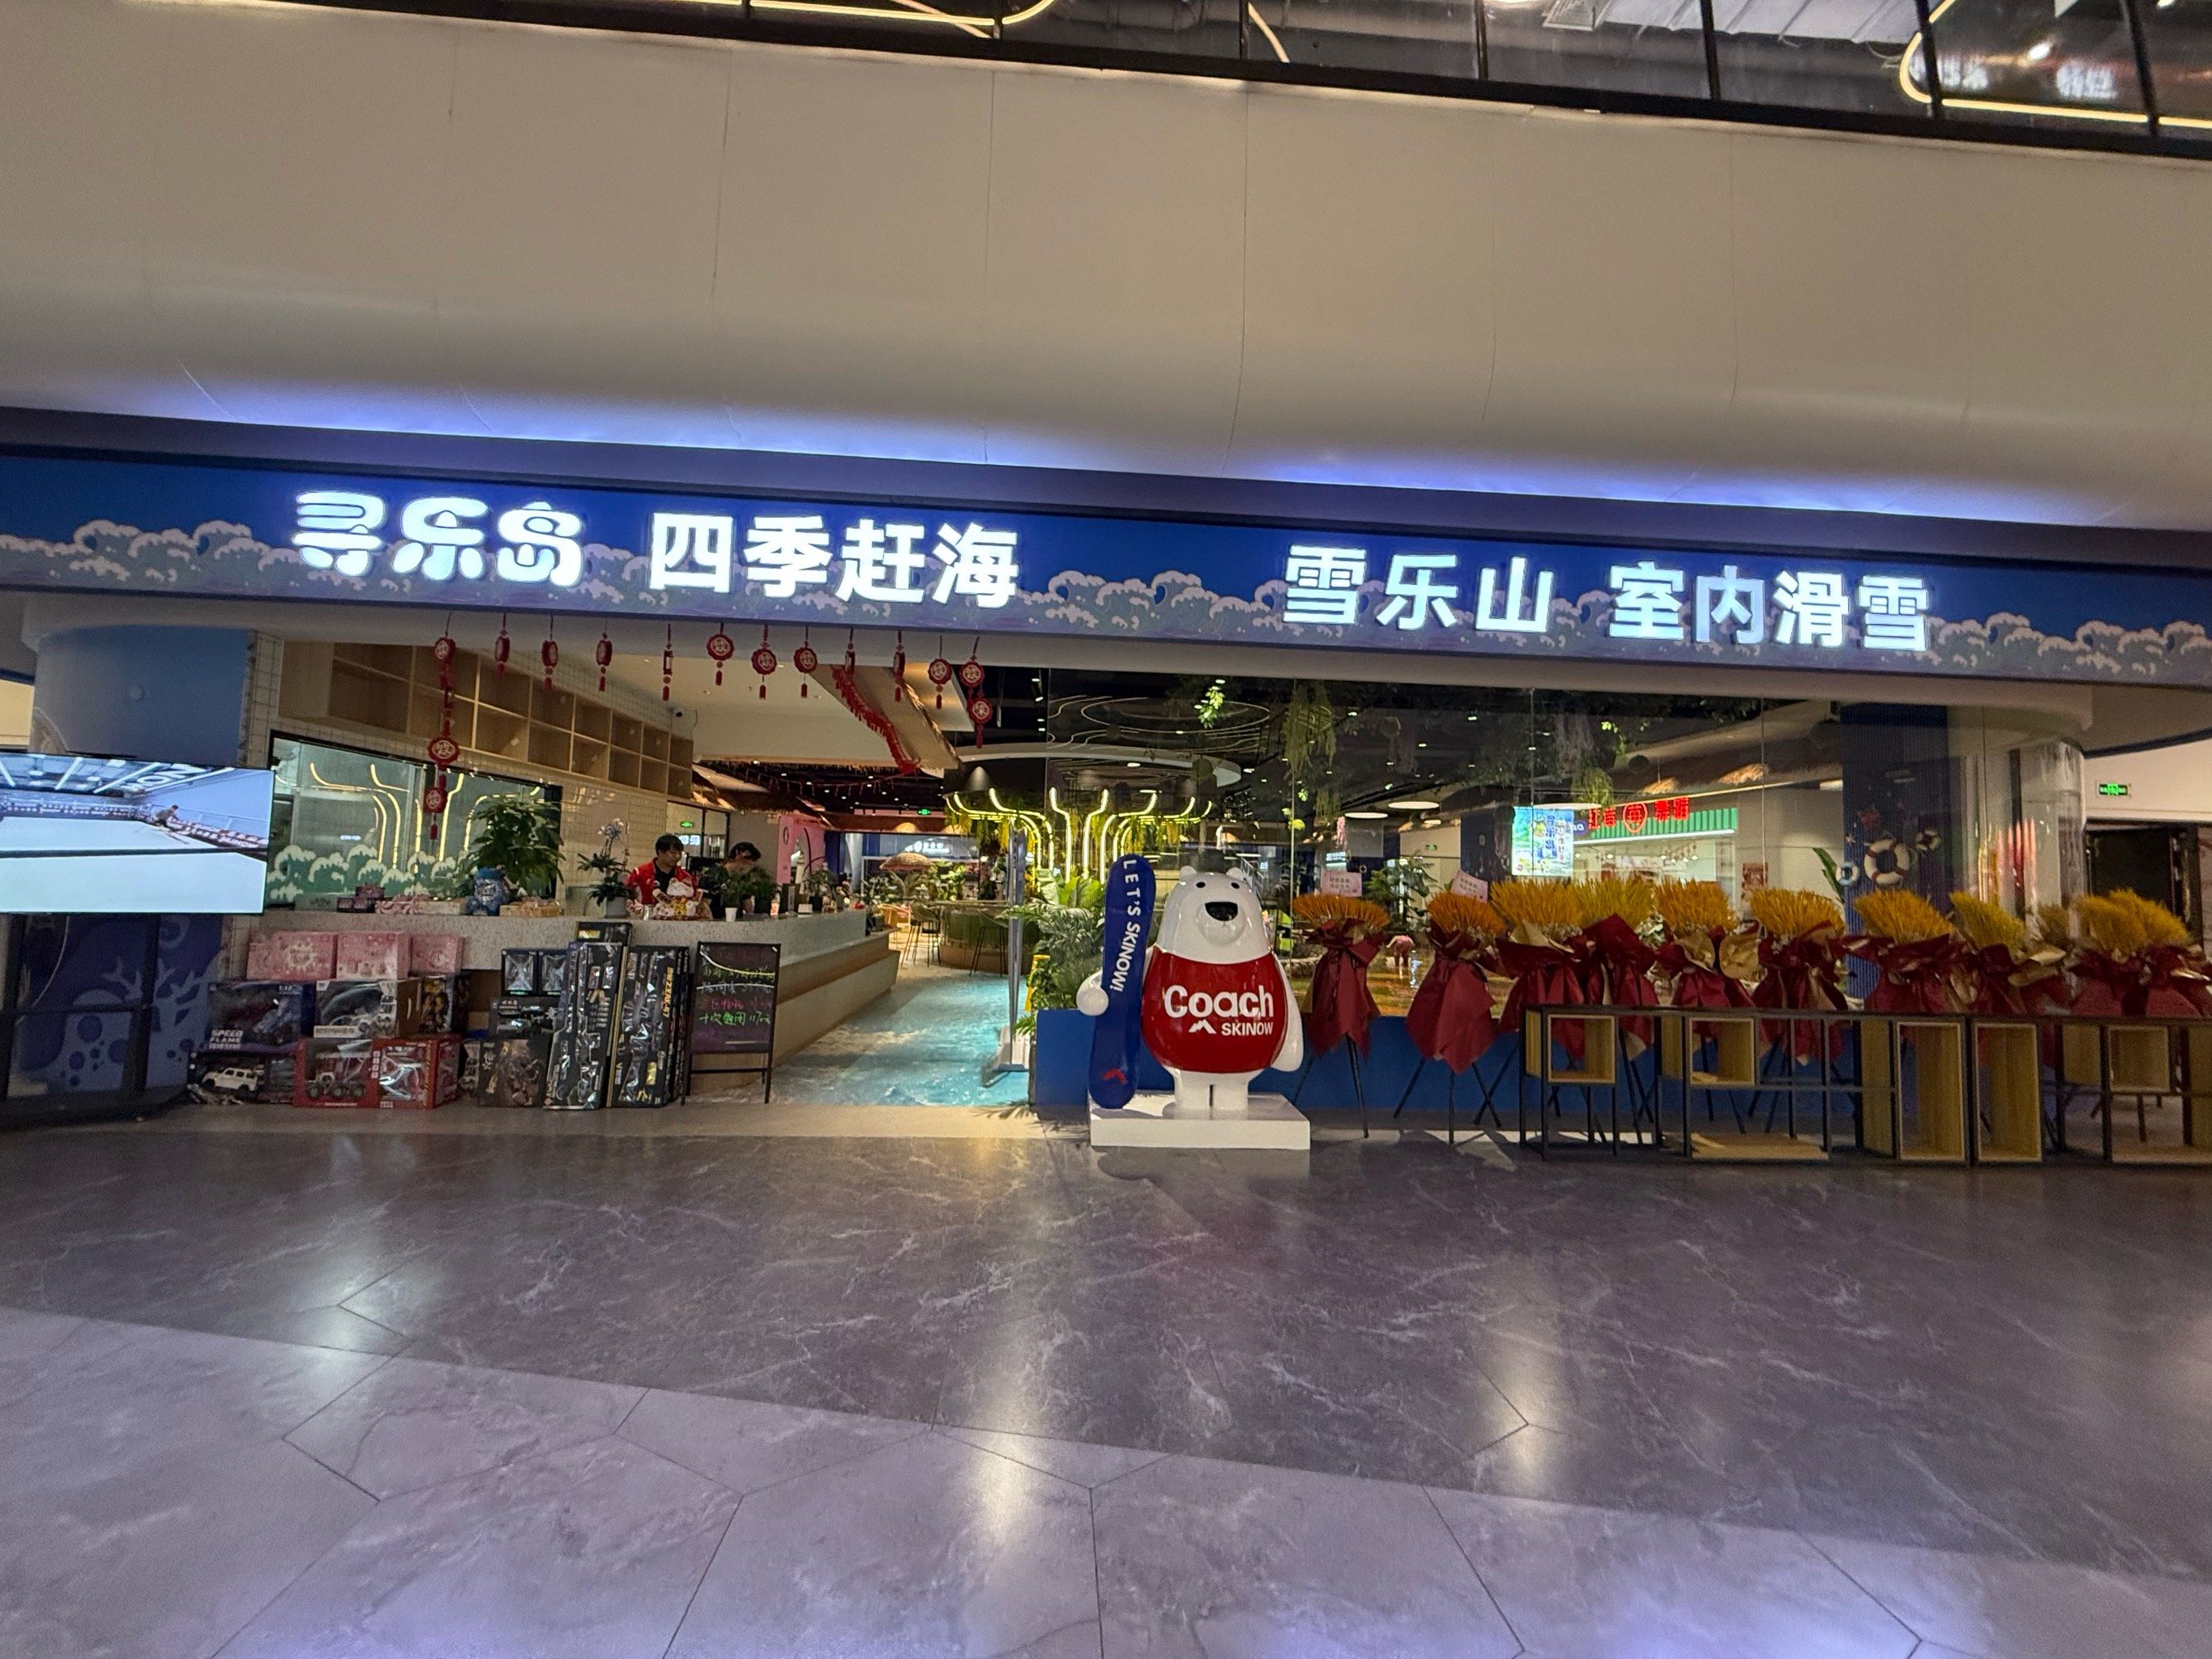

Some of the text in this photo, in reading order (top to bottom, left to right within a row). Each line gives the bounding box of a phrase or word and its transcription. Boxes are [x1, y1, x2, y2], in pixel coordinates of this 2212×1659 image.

[292, 490, 1018, 608] 寻乐岛 四季赶海
[1283, 544, 1929, 651] 雪乐山 室内滑雪
[1109, 921, 1141, 992] SKINOW!
[1164, 984, 1274, 1018] Coach
[1221, 1021, 1274, 1036] SKINOW
